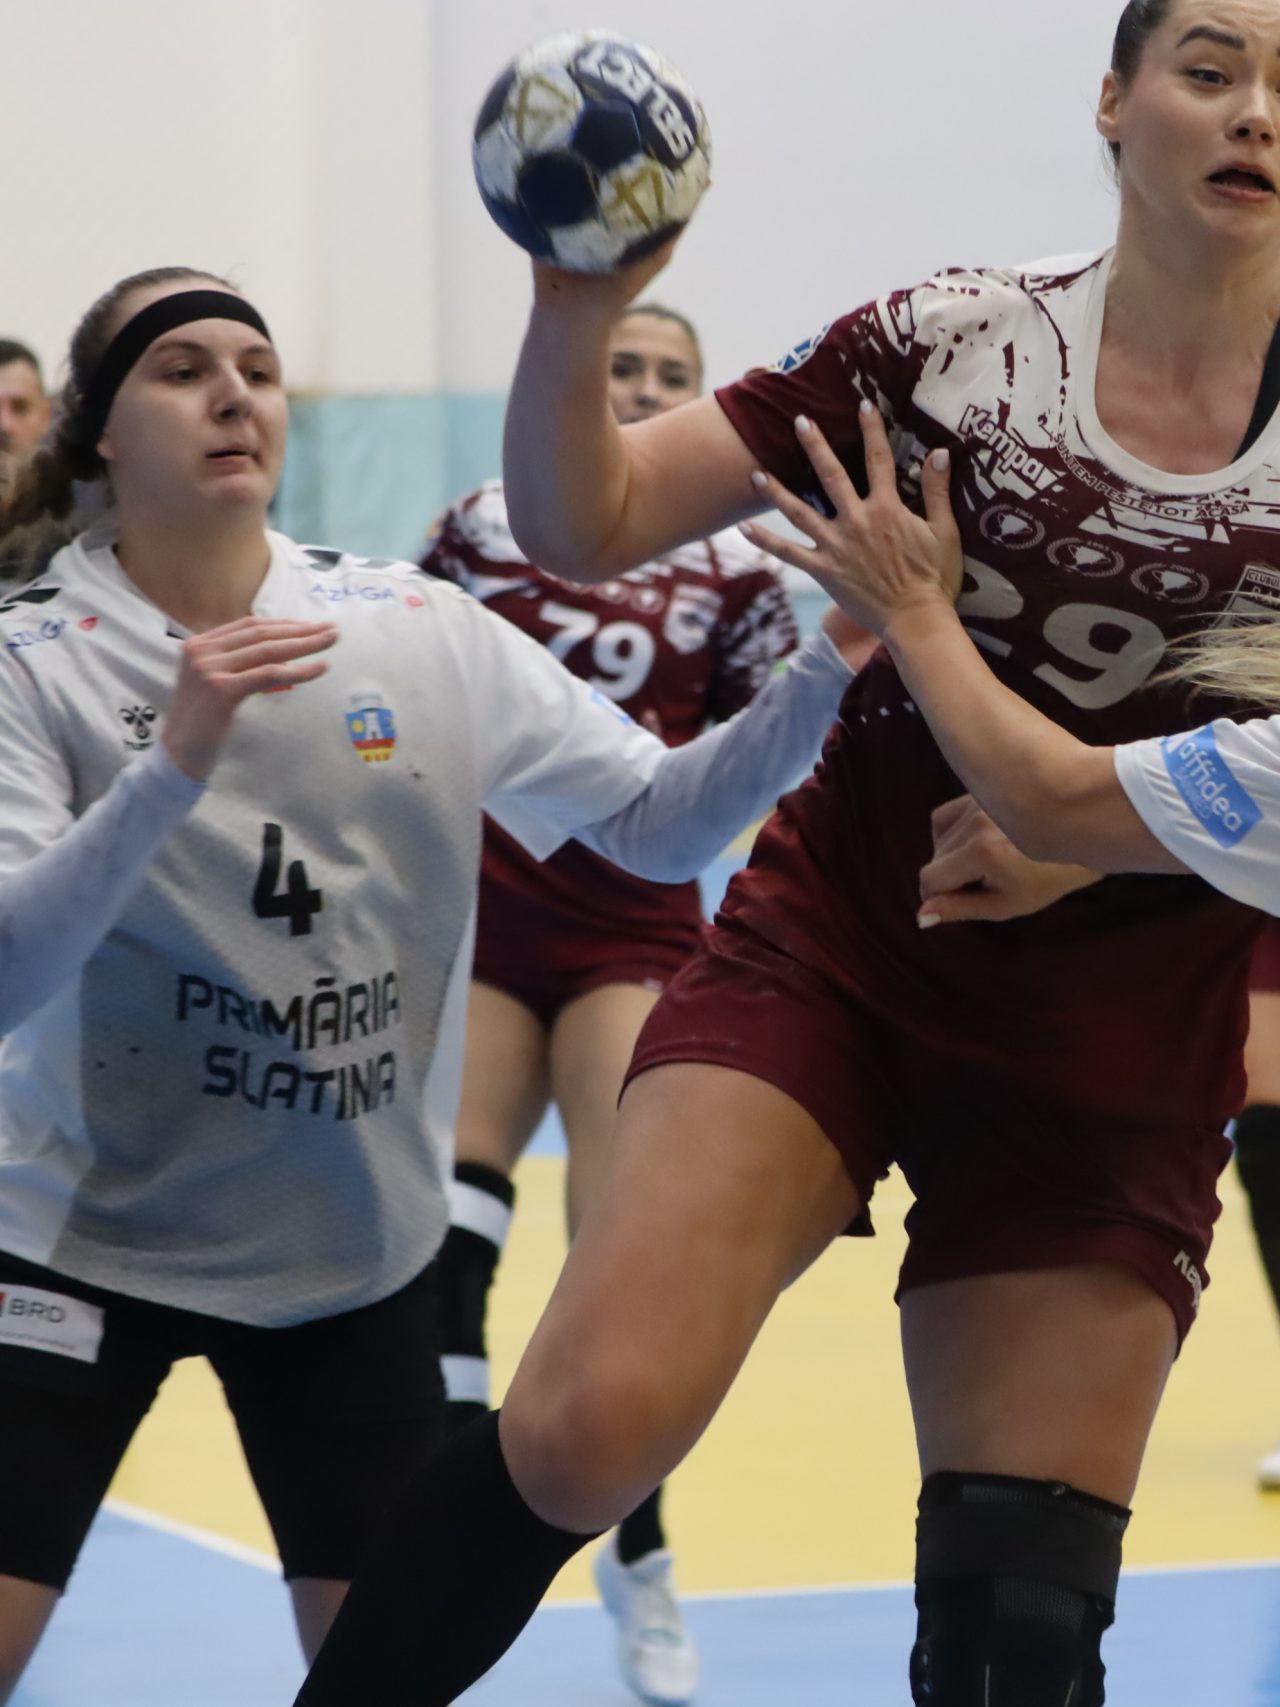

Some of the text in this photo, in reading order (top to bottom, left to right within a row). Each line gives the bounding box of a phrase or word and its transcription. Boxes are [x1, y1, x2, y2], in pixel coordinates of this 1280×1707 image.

[577, 46, 696, 160] SELECT
[957, 403, 1048, 485] Kempa
[1054, 433, 1097, 488] SUNTEM
[1094, 482, 1154, 513] PESTE
[1154, 503, 1192, 519] TOT
[538, 602, 657, 701] 79
[954, 554, 1168, 711] 29
[1179, 742, 1243, 833] affidea
[252, 822, 323, 937] 4
[177, 971, 400, 1051] PRIMĂRIA
[202, 1044, 396, 1122] SLATINA
[9, 1297, 67, 1324] BRD
